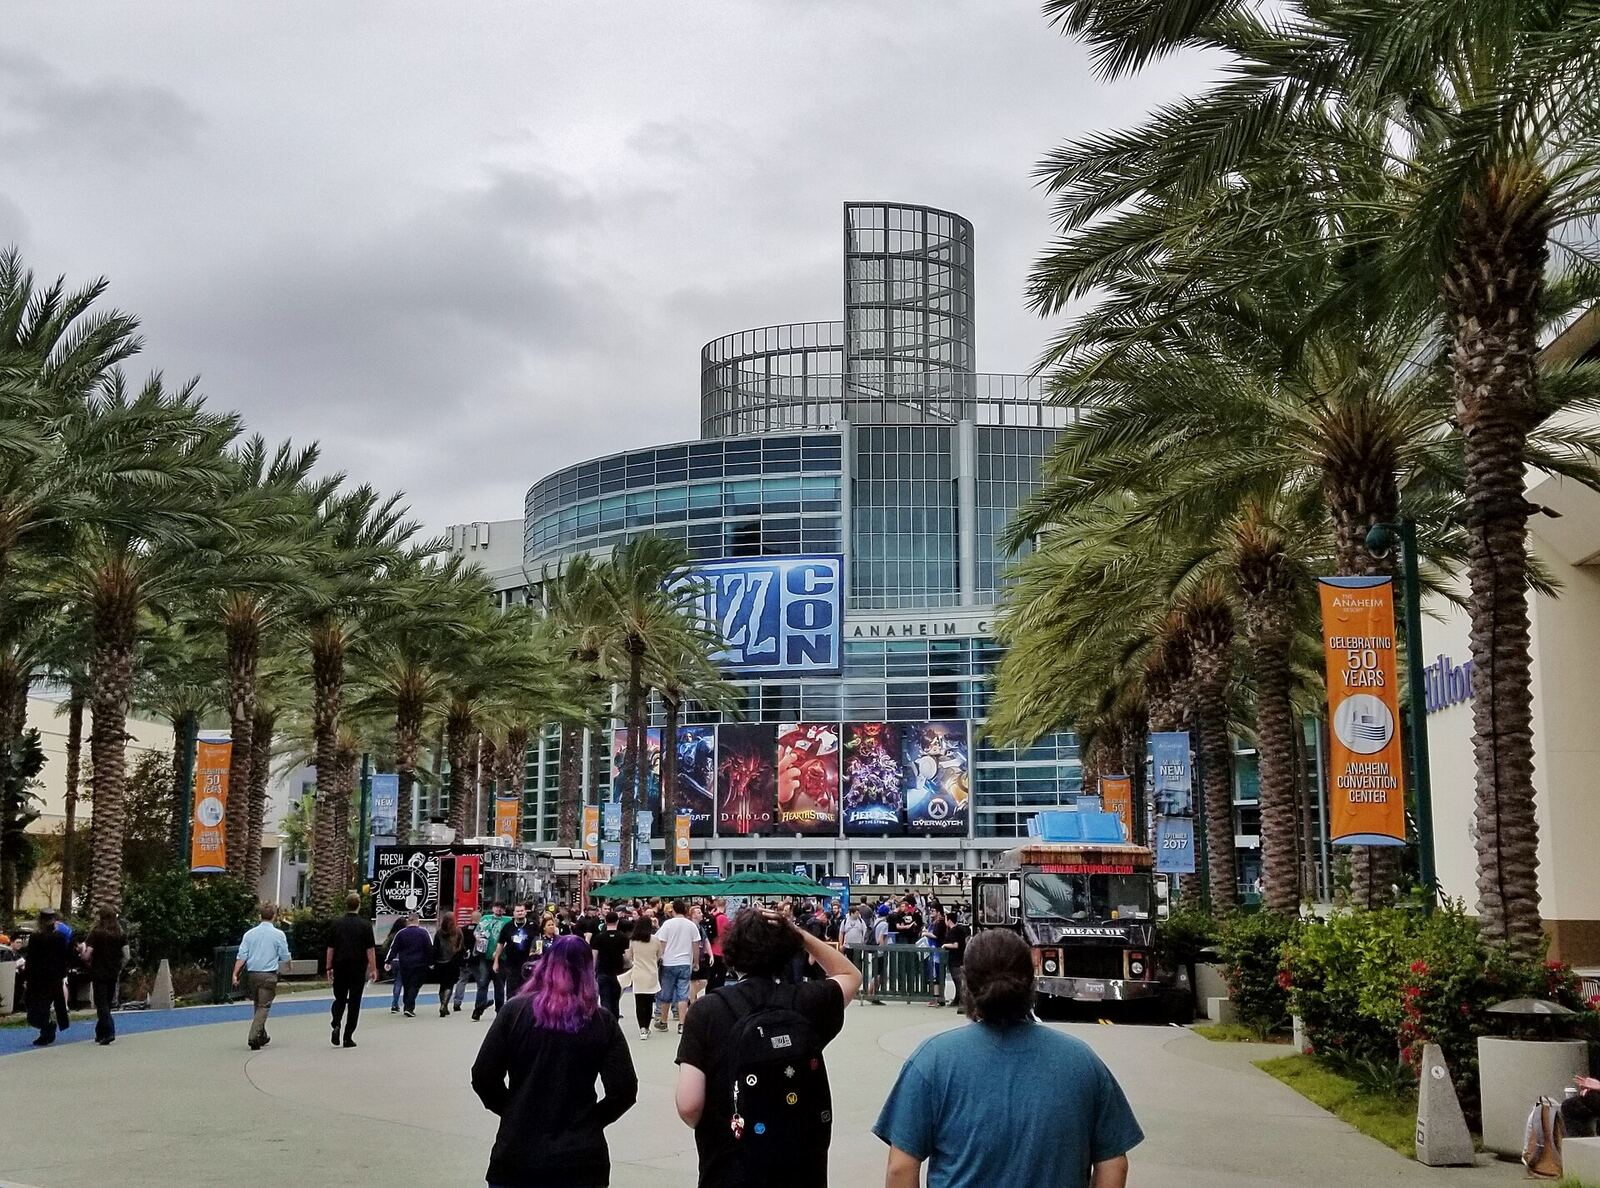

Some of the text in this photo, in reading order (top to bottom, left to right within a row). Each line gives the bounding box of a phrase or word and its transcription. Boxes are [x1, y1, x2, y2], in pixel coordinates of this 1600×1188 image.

[1332, 597, 1383, 607] ANAHEIM
[854, 623, 956, 637] ANAHEIM
[1329, 636, 1391, 649] CELEBRATING
[1348, 649, 1377, 670] 50
[1341, 670, 1385, 687] YEARS
[1160, 766, 1184, 776] NEW
[1345, 762, 1389, 775] ANAHEIM
[1337, 775, 1397, 788] CONVENTION
[1349, 790, 1387, 802] CENTER
[721, 812, 770, 821] DIABLO
[782, 810, 835, 823] HEARTHSTONE
[912, 819, 964, 827] OVERWATCH
[1163, 840, 1188, 849] 2017
[380, 854, 404, 865] FRESH
